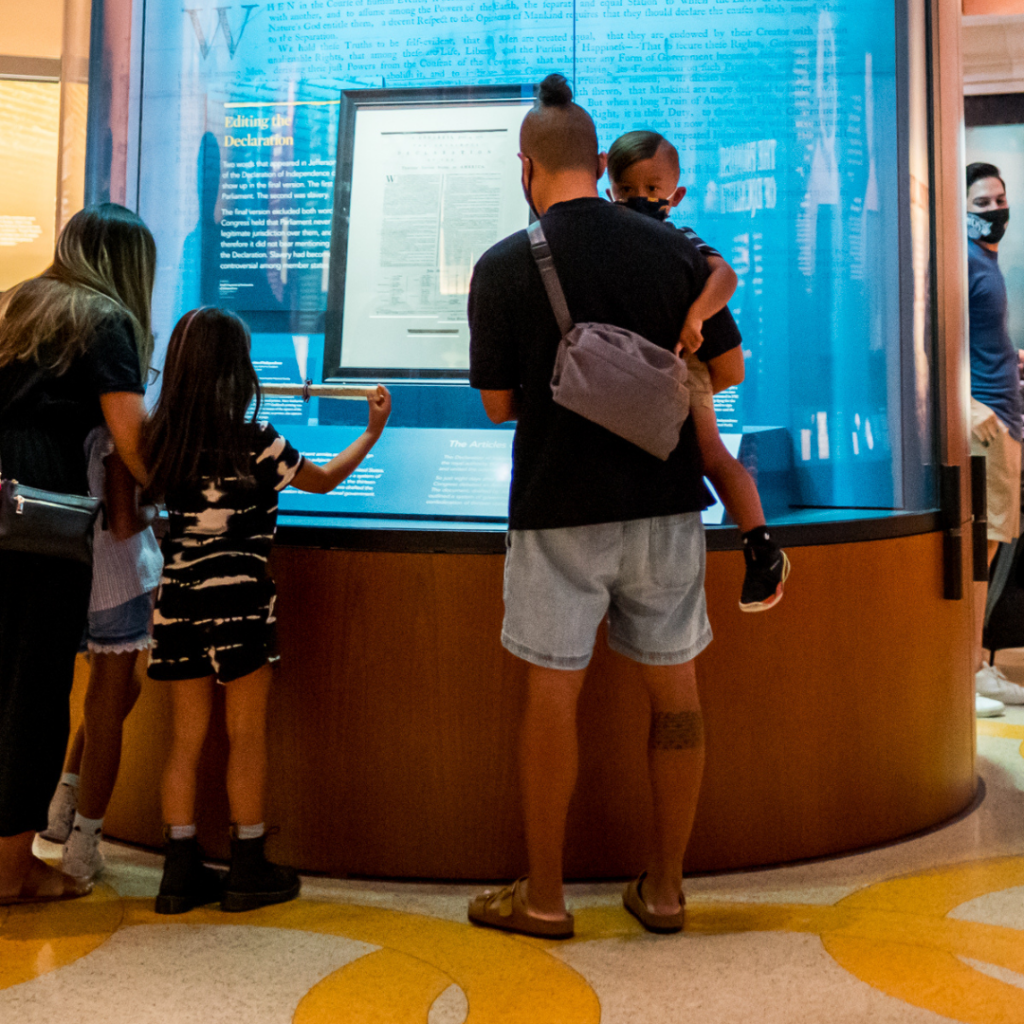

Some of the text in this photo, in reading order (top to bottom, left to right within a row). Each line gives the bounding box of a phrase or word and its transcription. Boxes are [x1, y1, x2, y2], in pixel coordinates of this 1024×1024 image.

[224, 113, 291, 130] Editing the
[224, 133, 294, 147] Declaration
